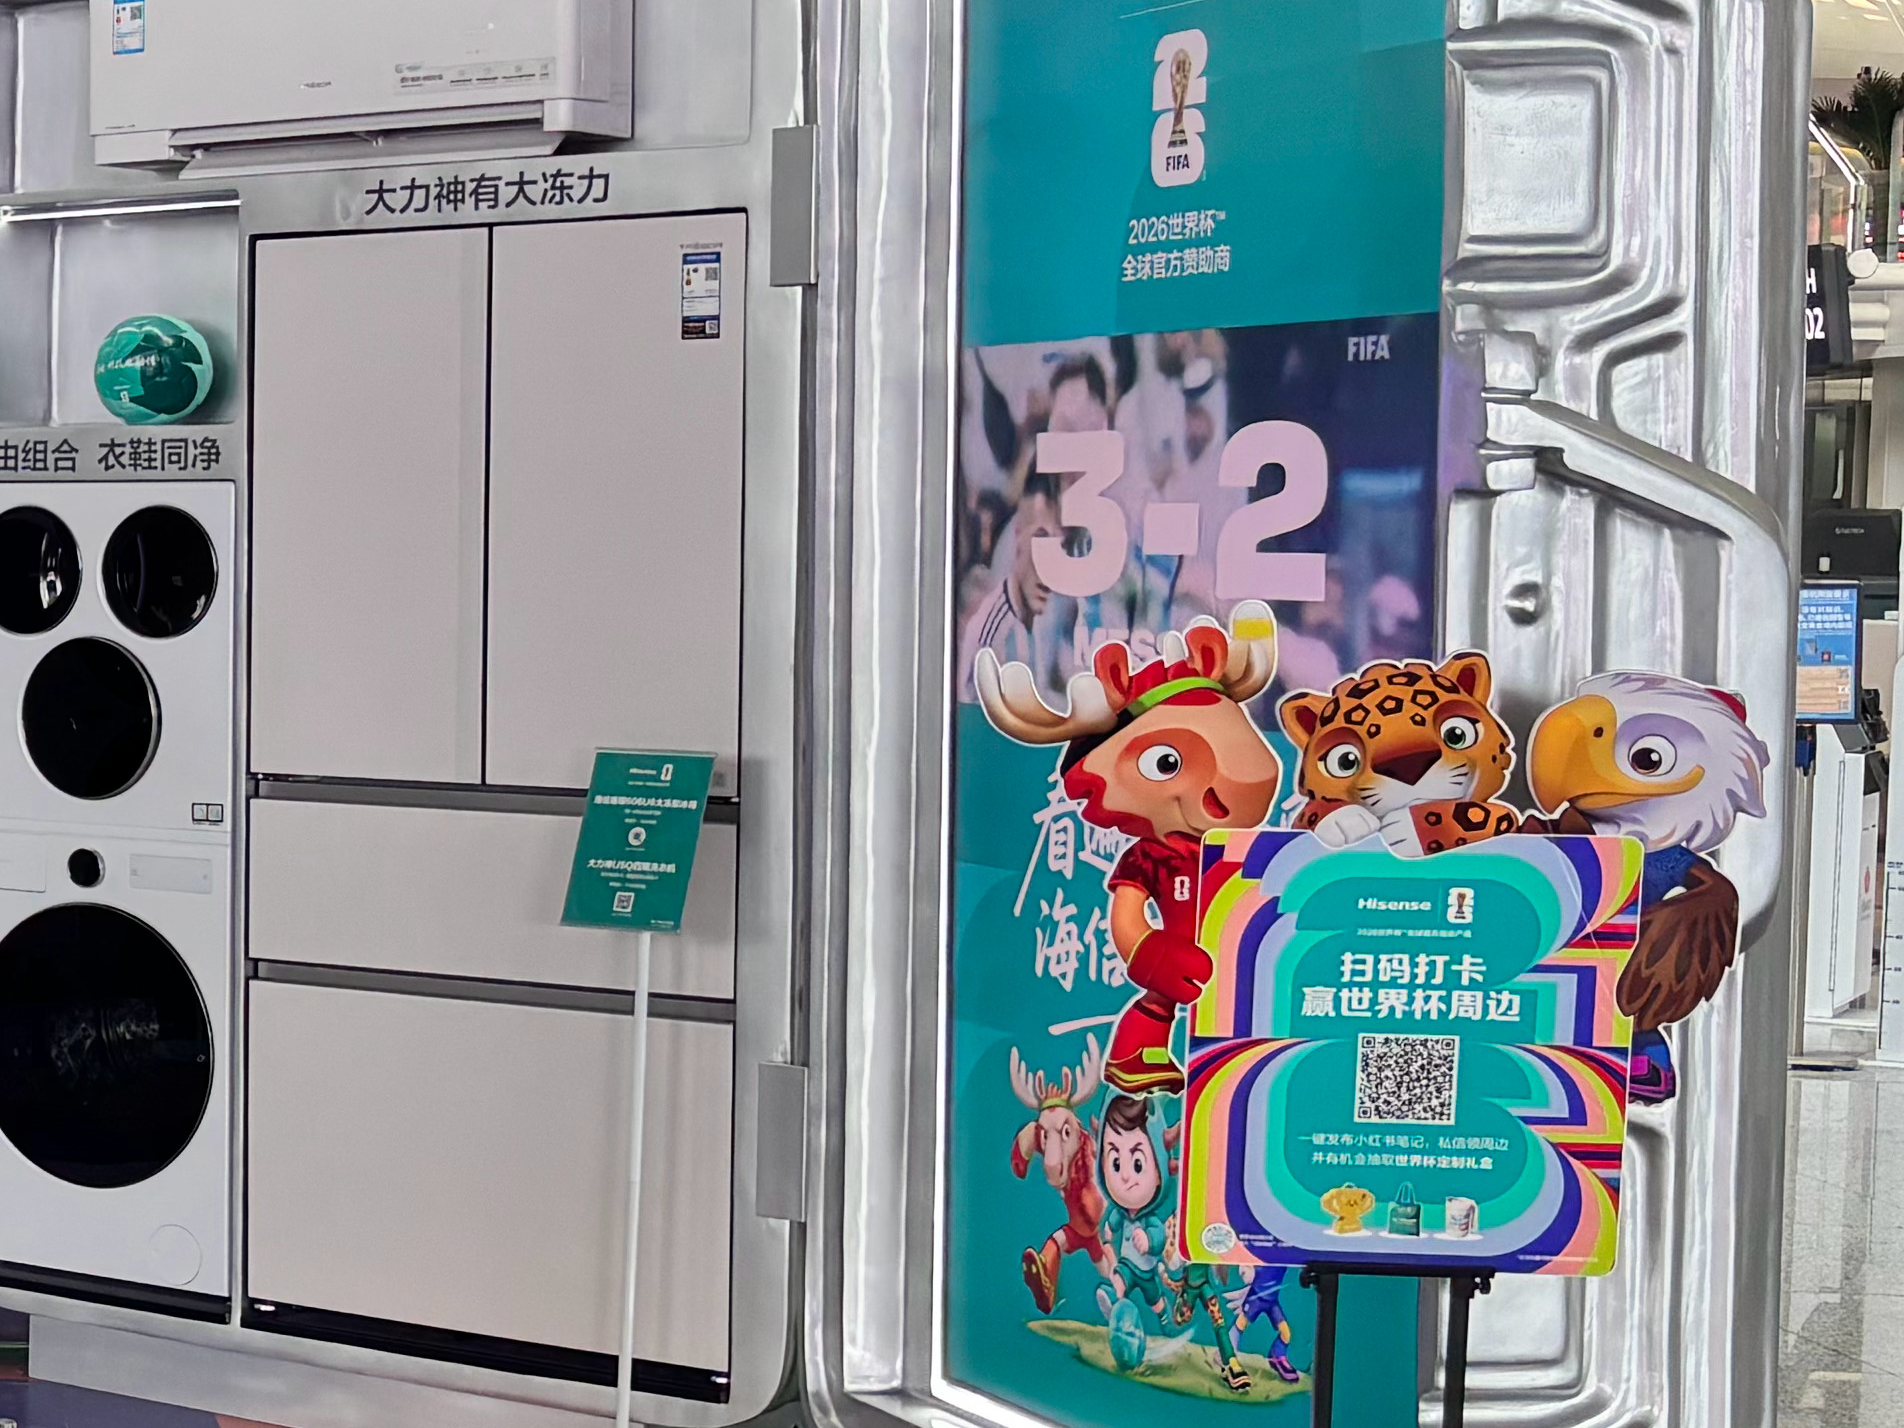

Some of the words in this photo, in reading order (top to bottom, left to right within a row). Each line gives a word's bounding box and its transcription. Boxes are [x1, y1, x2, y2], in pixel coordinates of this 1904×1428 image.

[1165, 153, 1191, 172] FIFA
[365, 170, 610, 216] 大力神有大冻力
[1121, 244, 1231, 283] 全球官方赞助商
[1804, 307, 1826, 340] 02
[1347, 334, 1391, 362] FIFA
[97, 438, 222, 472] 衣鞋同净
[1031, 420, 1329, 602] 3-2
[1357, 897, 1432, 912] Hisense
[1340, 952, 1487, 986] 扫码打卡
[1301, 986, 1521, 1022] 赢世界杯周边
